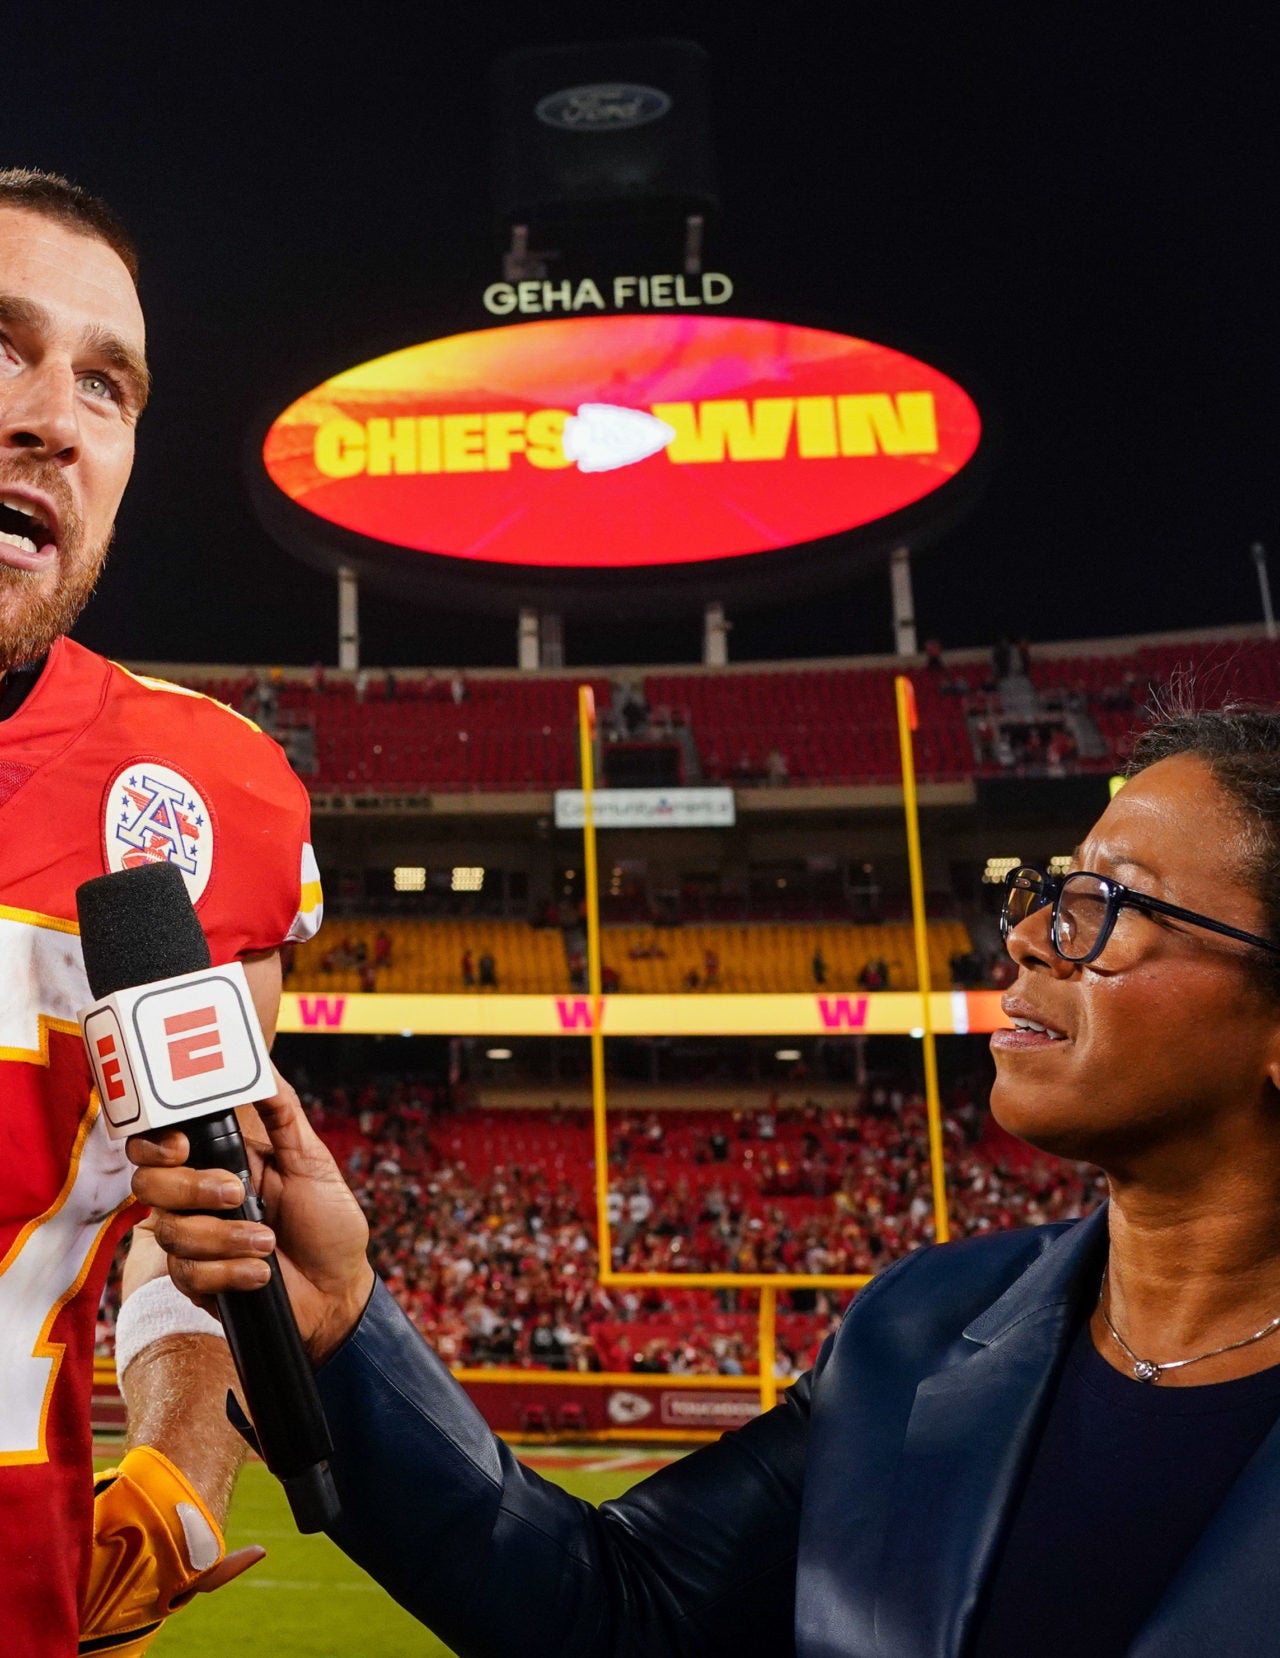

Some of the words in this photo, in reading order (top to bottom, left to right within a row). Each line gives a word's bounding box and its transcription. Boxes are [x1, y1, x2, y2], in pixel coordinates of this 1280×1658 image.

[483, 279, 604, 315] GEHA
[614, 273, 733, 309] FIELD
[313, 410, 567, 478] CHIEFS
[651, 392, 939, 464] WIN
[297, 996, 346, 1030] W
[556, 998, 606, 1030] W
[817, 996, 869, 1030] W
[163, 1005, 224, 1081] E
[96, 1034, 126, 1101] E
